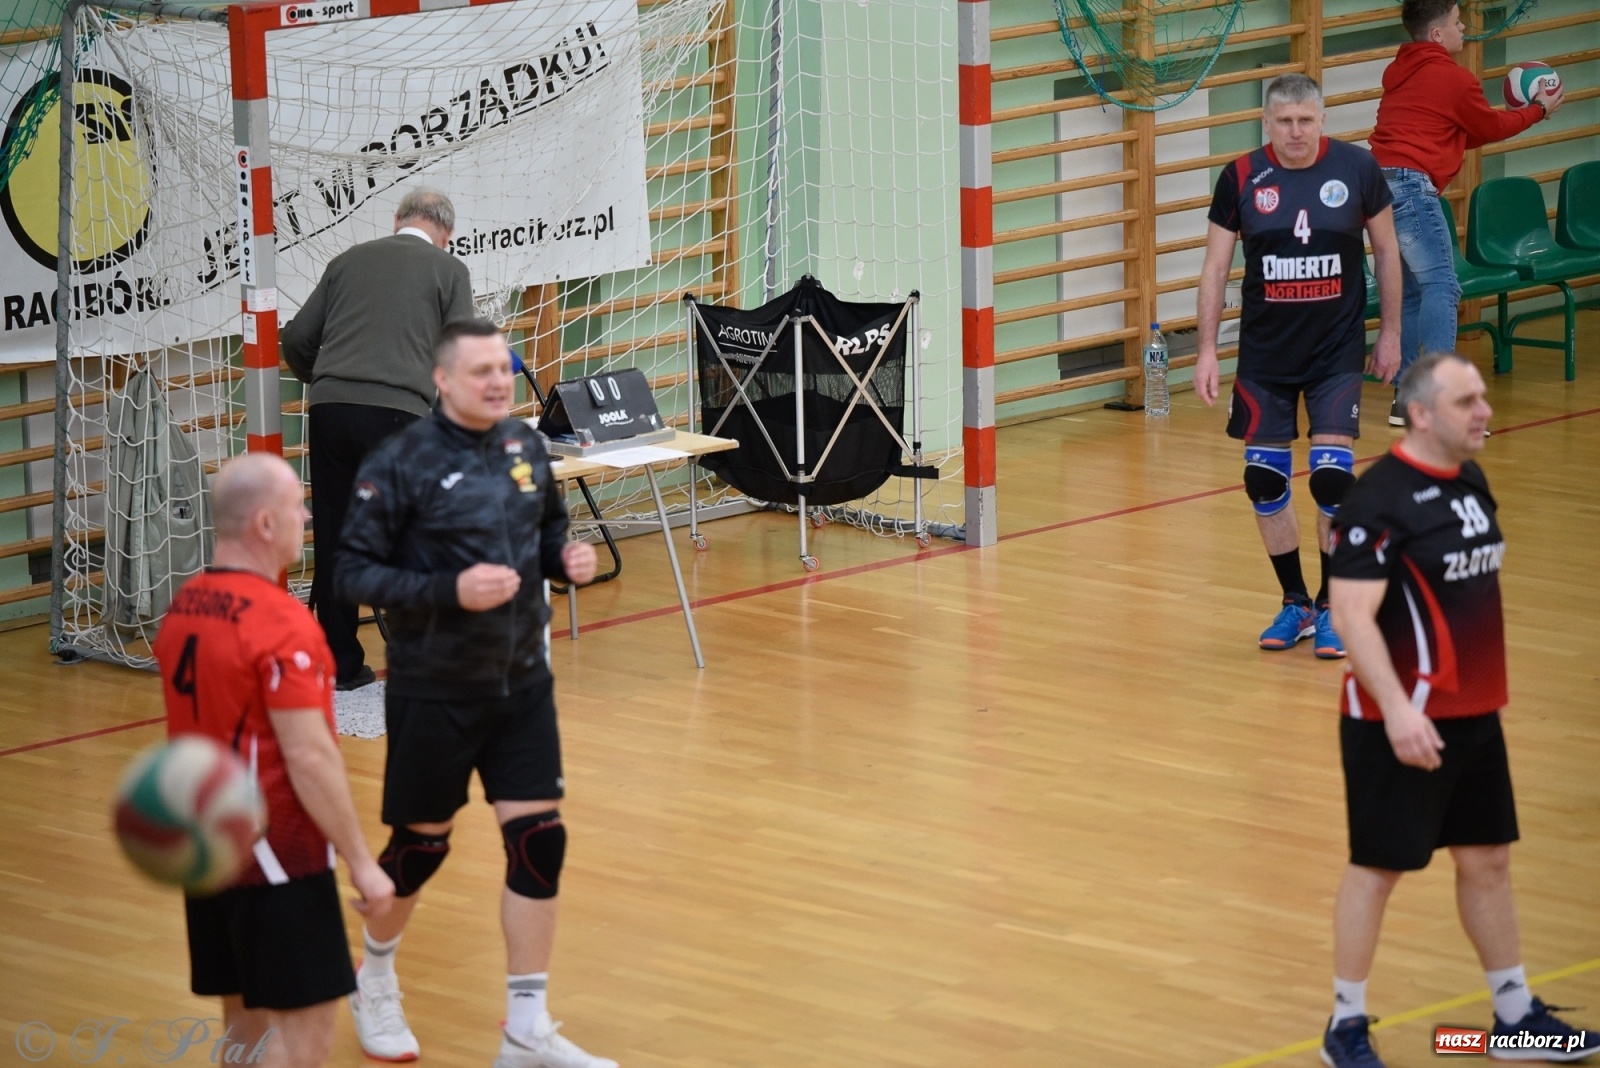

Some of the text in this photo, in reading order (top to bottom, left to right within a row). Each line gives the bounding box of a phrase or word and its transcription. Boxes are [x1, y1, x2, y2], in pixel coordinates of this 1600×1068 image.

[197, 188, 300, 284] JET
[1293, 208, 1311, 244] 4
[589, 376, 622, 401] 0 0
[173, 633, 199, 723] 4
